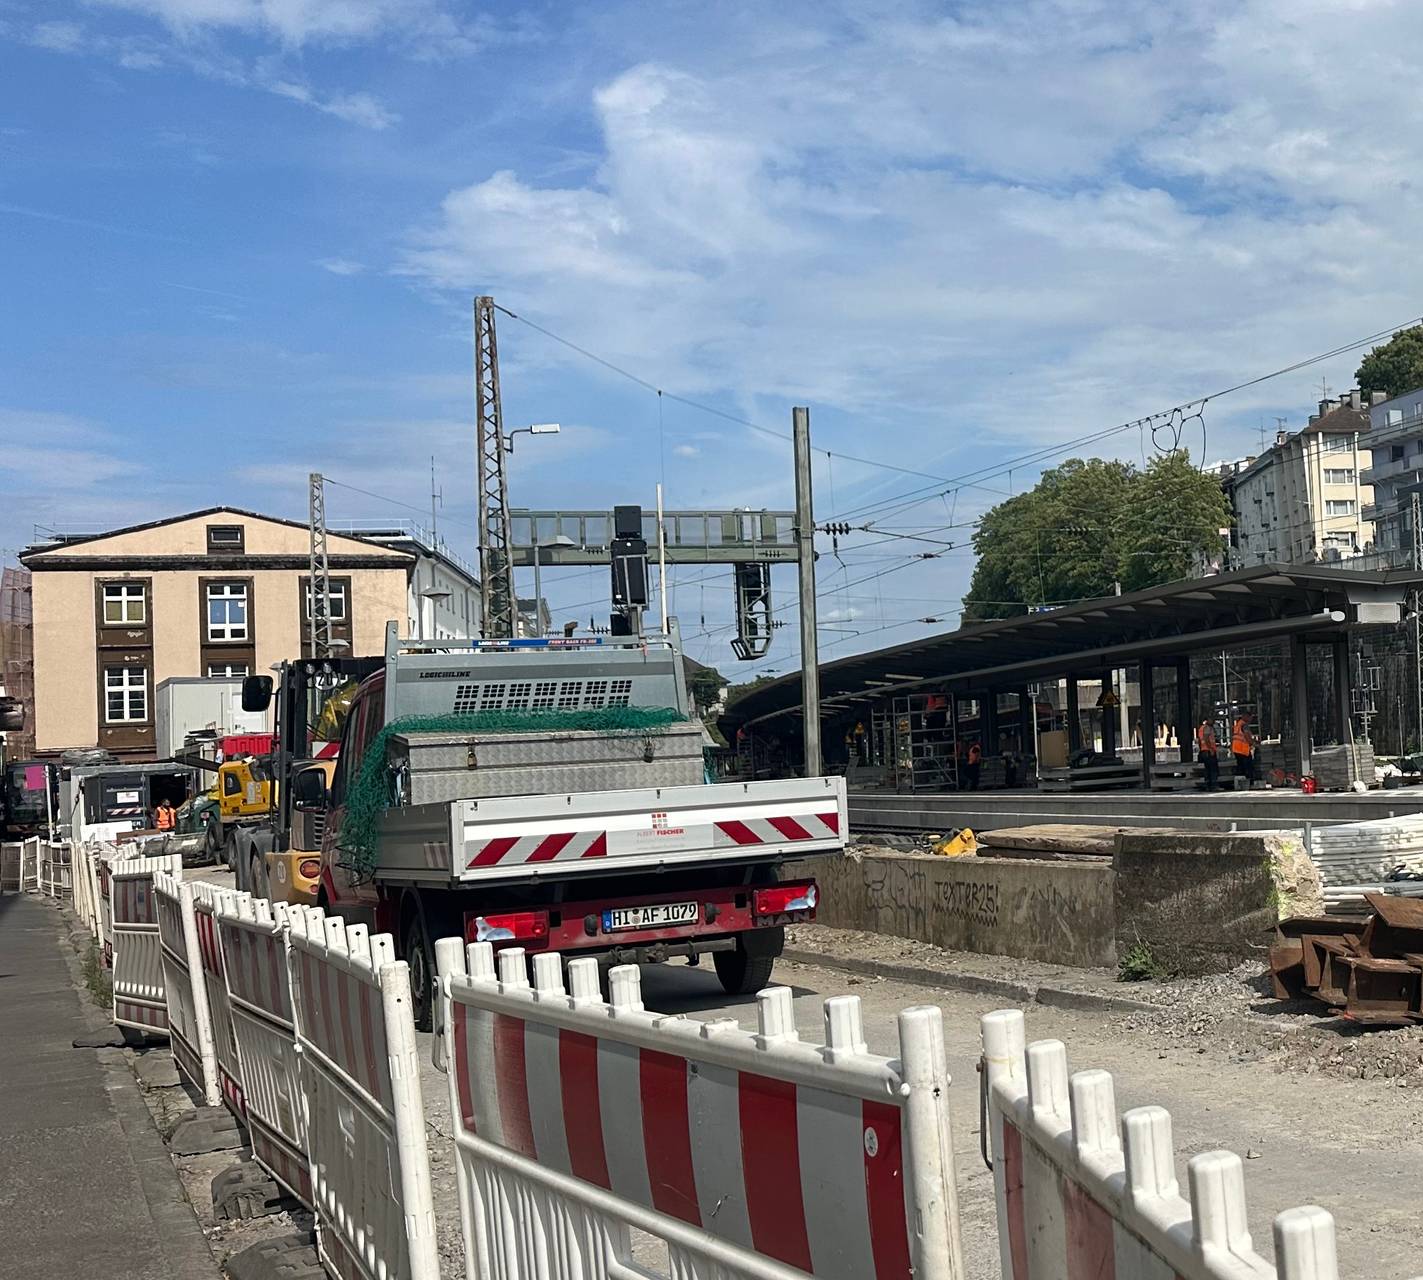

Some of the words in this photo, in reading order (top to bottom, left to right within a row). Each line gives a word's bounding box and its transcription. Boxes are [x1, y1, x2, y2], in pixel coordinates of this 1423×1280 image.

[657, 828, 684, 836] FISCHER
[612, 910, 630, 926] HI
[642, 907, 660, 923] AF
[663, 903, 697, 921] 1079
[757, 910, 811, 927] MAN
